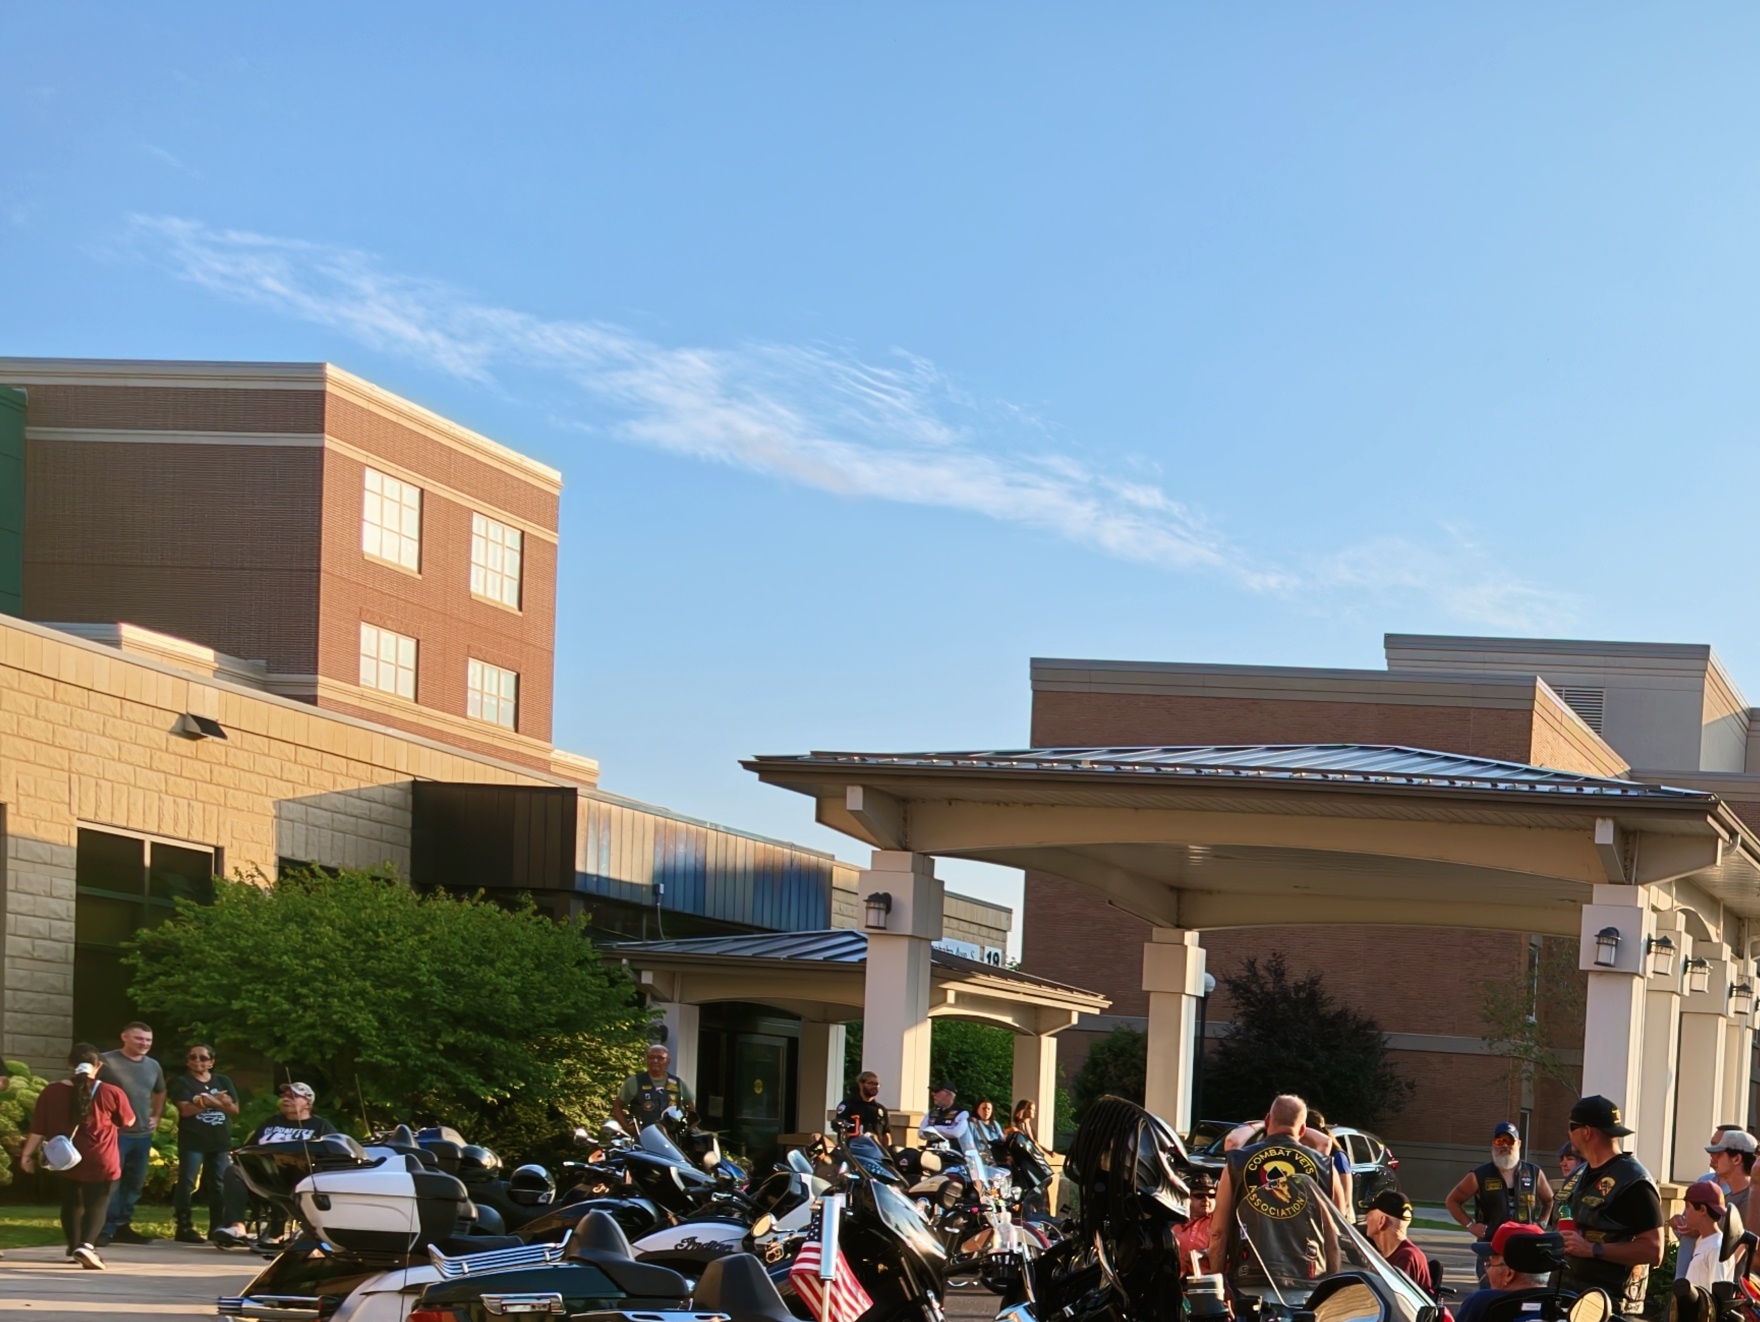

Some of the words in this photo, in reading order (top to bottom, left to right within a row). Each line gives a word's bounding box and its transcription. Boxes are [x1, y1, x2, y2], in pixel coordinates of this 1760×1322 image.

[1248, 1148, 1292, 1172] COMBAT
[1294, 1153, 1315, 1175] VETS
[1248, 1184, 1306, 1217] ASSOCIATION
